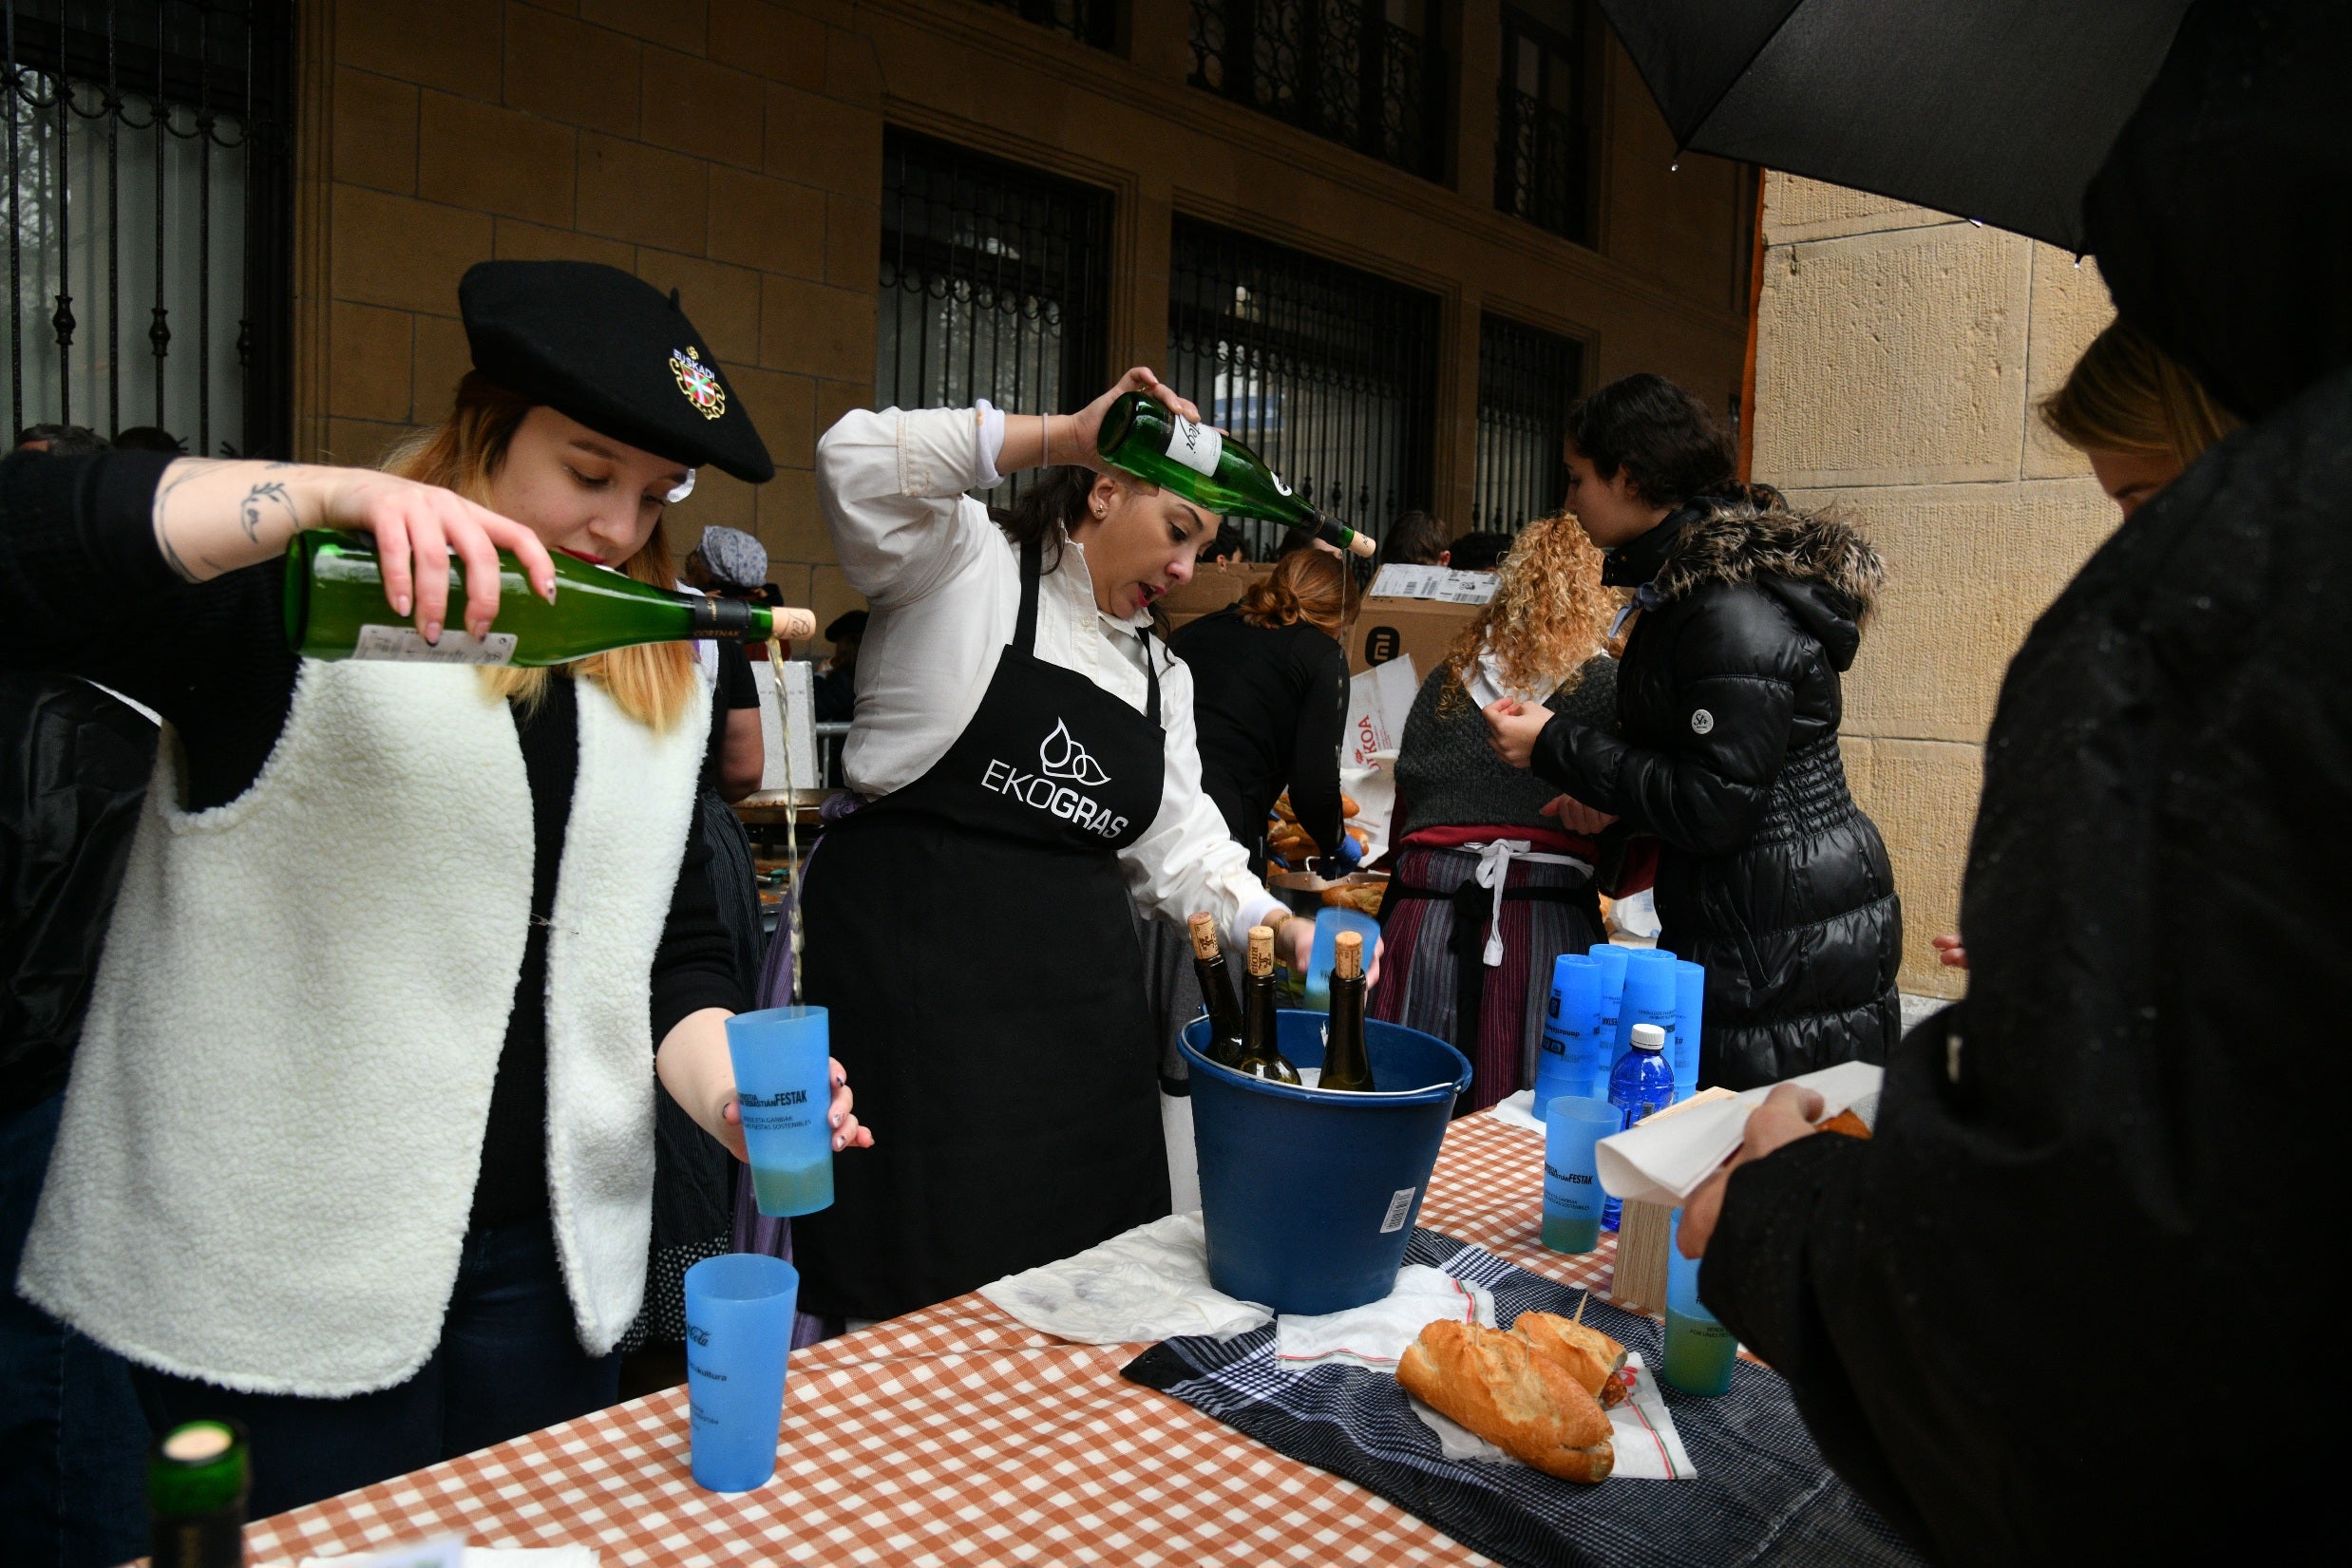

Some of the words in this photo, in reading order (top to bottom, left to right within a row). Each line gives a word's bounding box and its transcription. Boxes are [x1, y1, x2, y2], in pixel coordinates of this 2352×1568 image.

[673, 349, 714, 381] EUSKADI
[981, 759, 1129, 839] EKOGRAS
[775, 1090, 807, 1106] FESTAK
[1568, 1173, 1593, 1185] FESTAK
